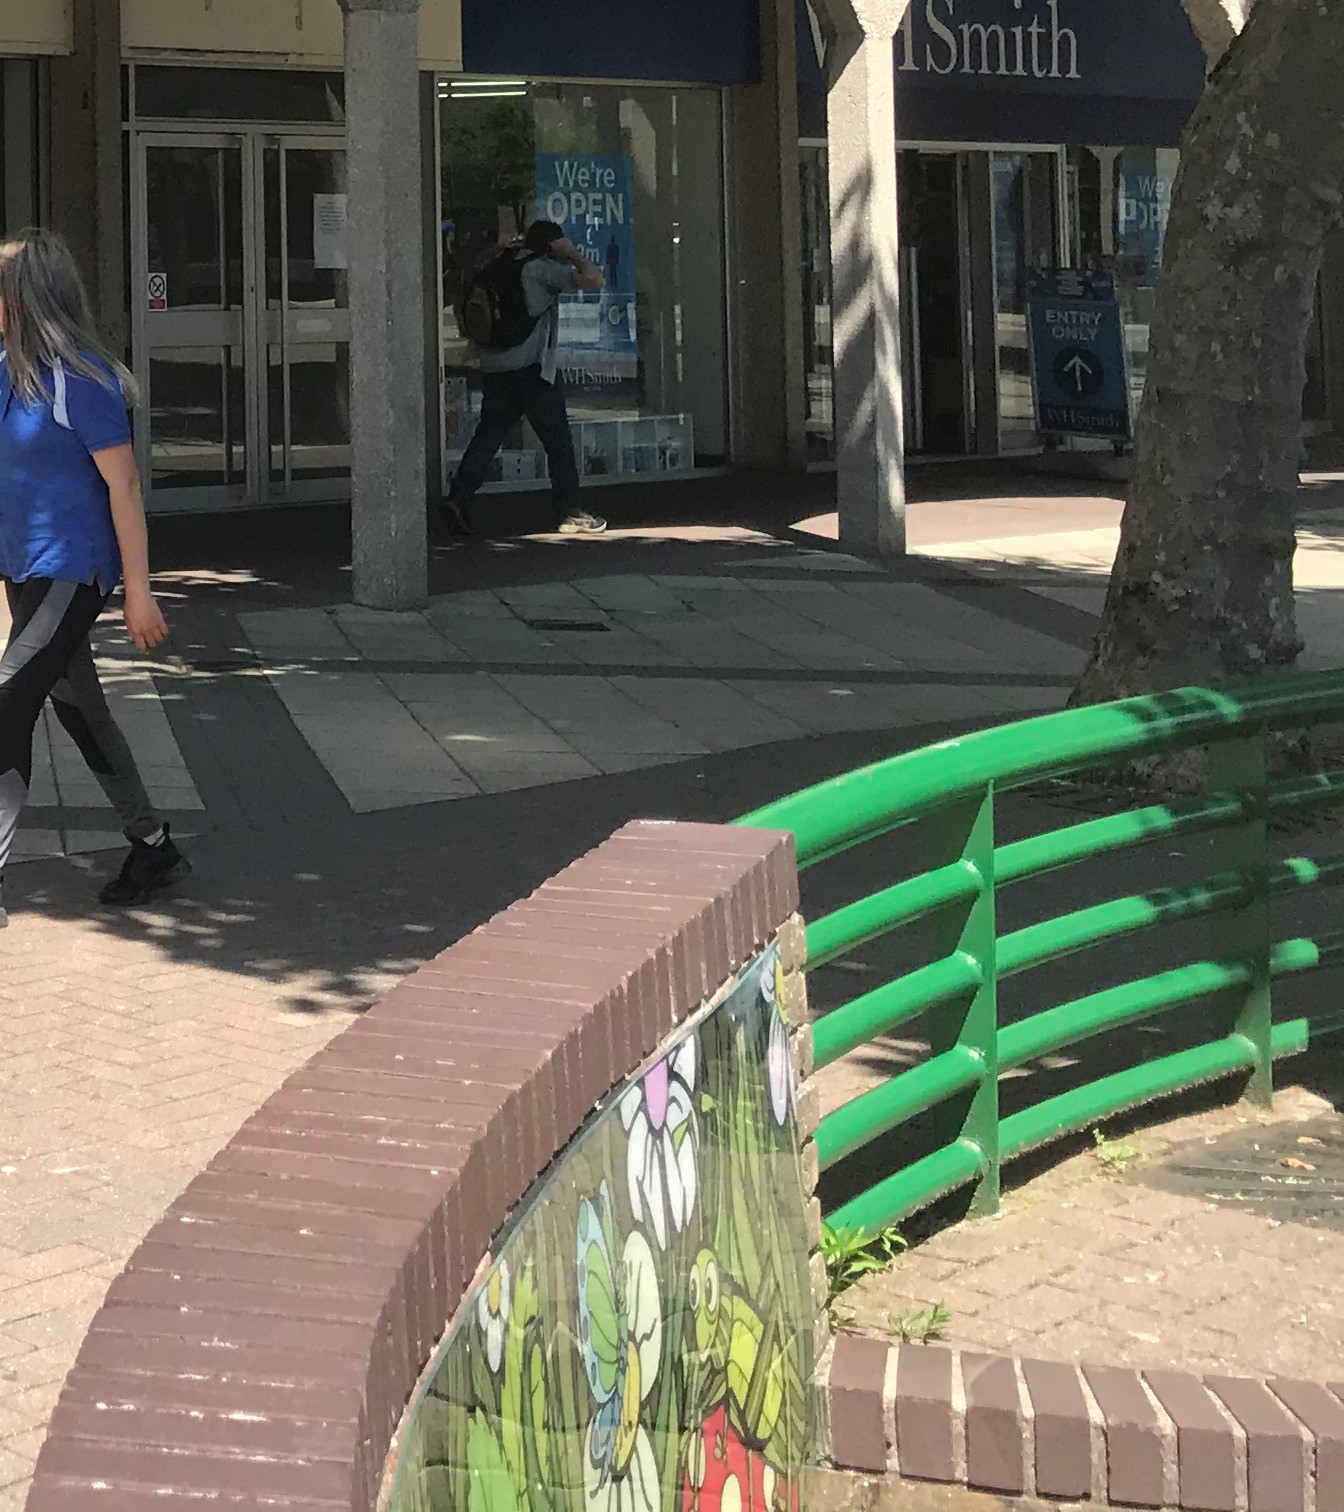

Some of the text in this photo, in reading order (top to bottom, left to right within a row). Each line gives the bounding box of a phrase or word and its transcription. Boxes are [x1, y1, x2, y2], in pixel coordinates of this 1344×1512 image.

[554, 160, 615, 188] We're
[546, 191, 625, 225] OPEN
[1045, 308, 1102, 327] ENTRY
[1051, 326, 1098, 342] ONLY
